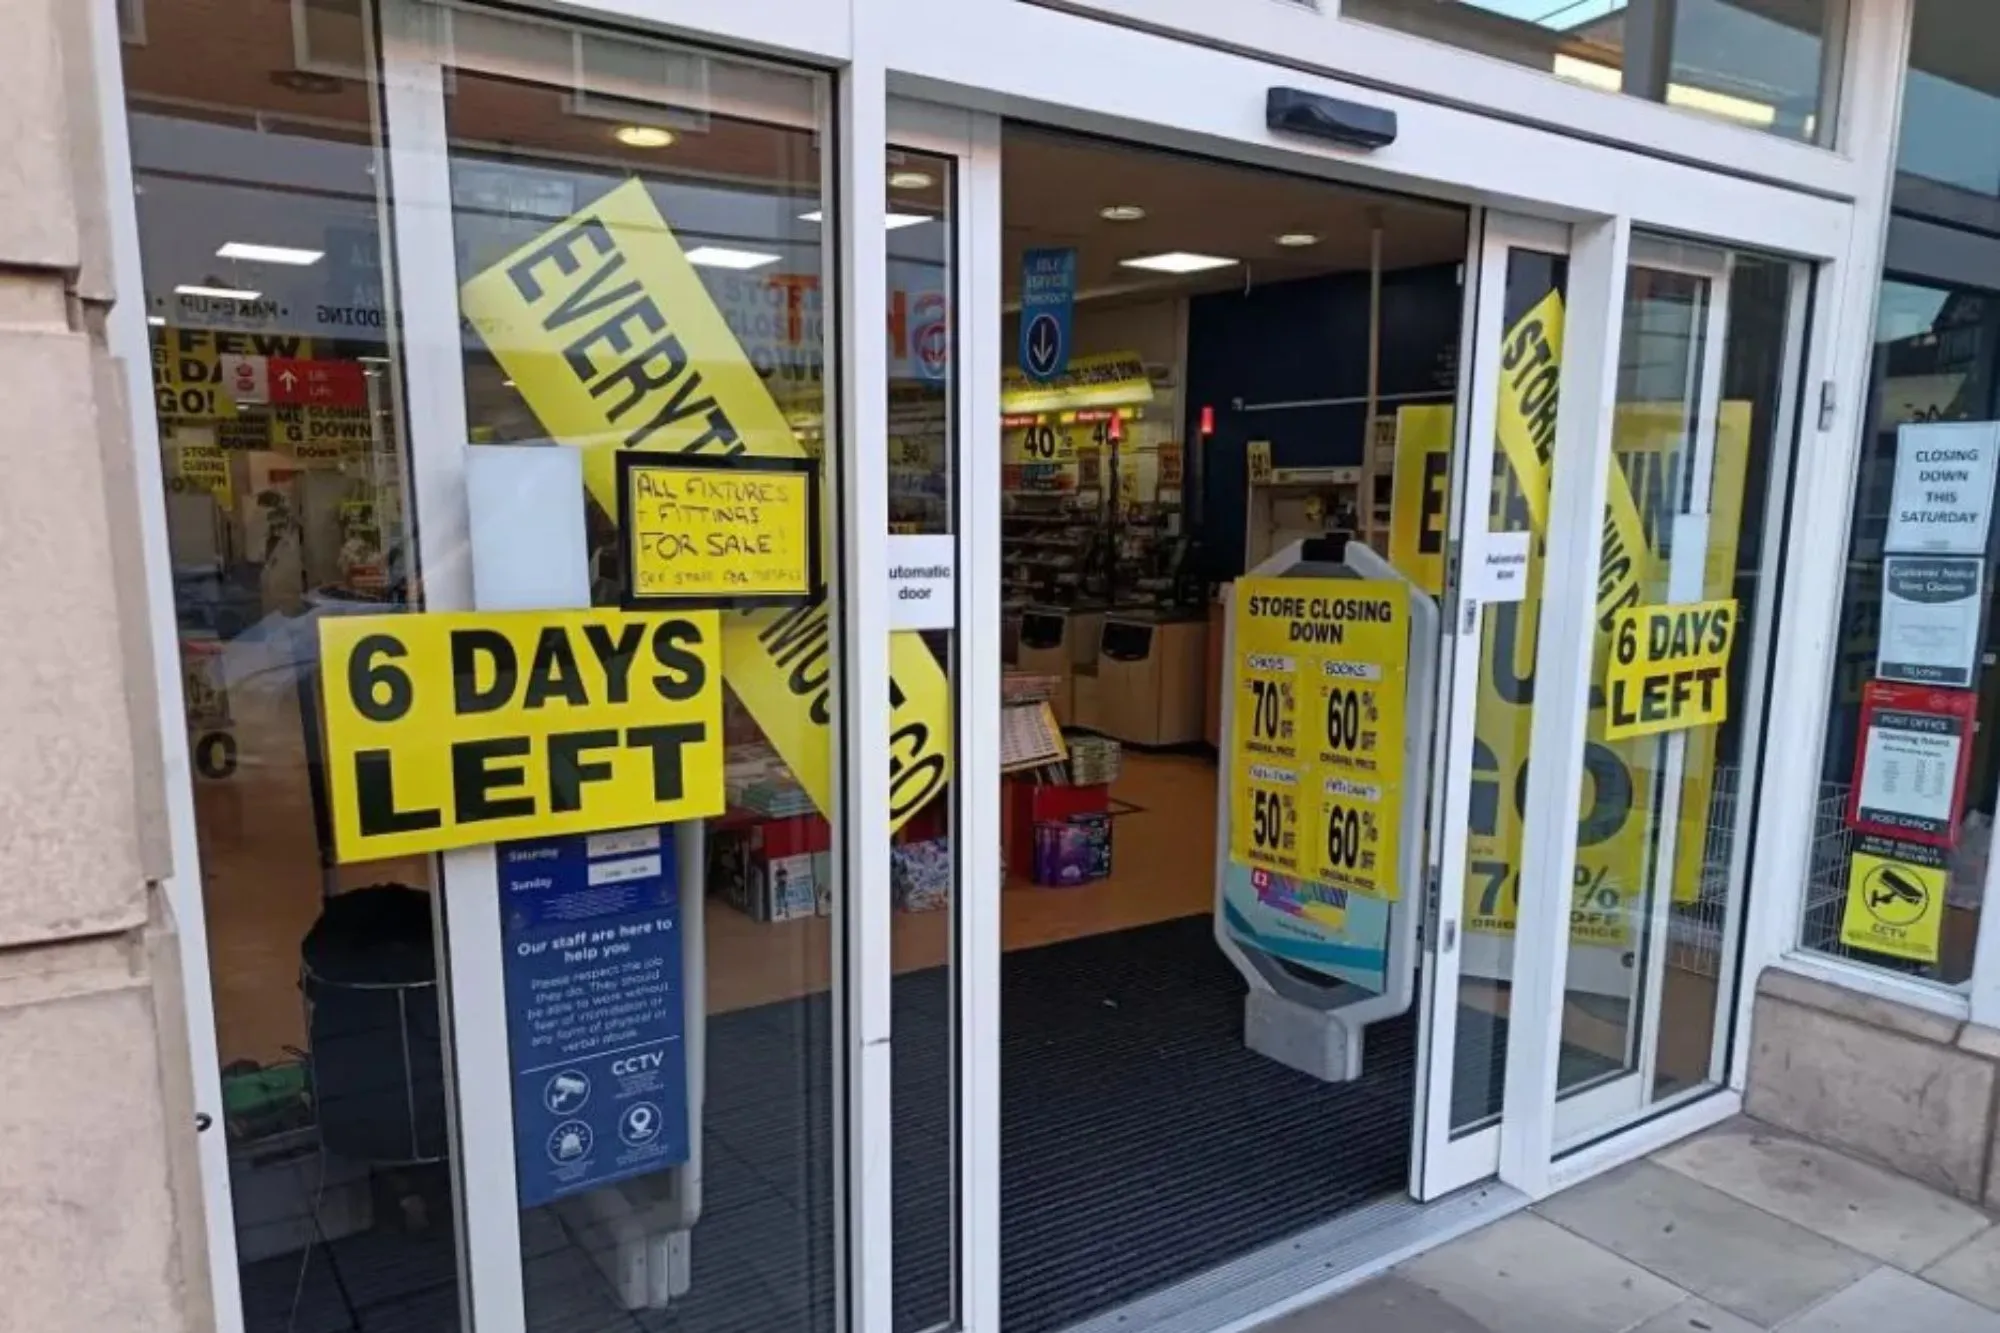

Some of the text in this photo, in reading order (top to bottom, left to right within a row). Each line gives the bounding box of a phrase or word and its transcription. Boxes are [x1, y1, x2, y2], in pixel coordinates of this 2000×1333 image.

[505, 214, 747, 457] EVERYT
[1915, 449, 1979, 463] CLOSING
[637, 471, 790, 505] ALL FIXTURES
[1919, 470, 1968, 482] DOWN
[1926, 491, 1957, 503] THIS
[659, 501, 760, 525] FITTINGS
[1900, 510, 1978, 523] SATURDAY
[639, 531, 700, 561] FOR
[887, 563, 951, 582] utomatic
[897, 585, 932, 602] door
[1249, 595, 1392, 623] STORE CLOSING
[1288, 622, 1343, 645] DOWN
[1616, 618, 1638, 665] 6
[1648, 607, 1729, 662] DAYS
[347, 618, 707, 722] 6 DAYS
[1611, 666, 1721, 728] LEFT
[354, 721, 707, 837] LEFT
[507, 847, 559, 863] Saturday
[510, 876, 553, 892] Sunday
[1470, 918, 1517, 931] ORIG
[517, 918, 673, 957] Our staff are here to
[563, 940, 632, 964] help you
[573, 965, 620, 984] respect
[643, 955, 665, 971] job
[621, 968, 660, 987] should
[610, 1050, 665, 1077] CCTV
